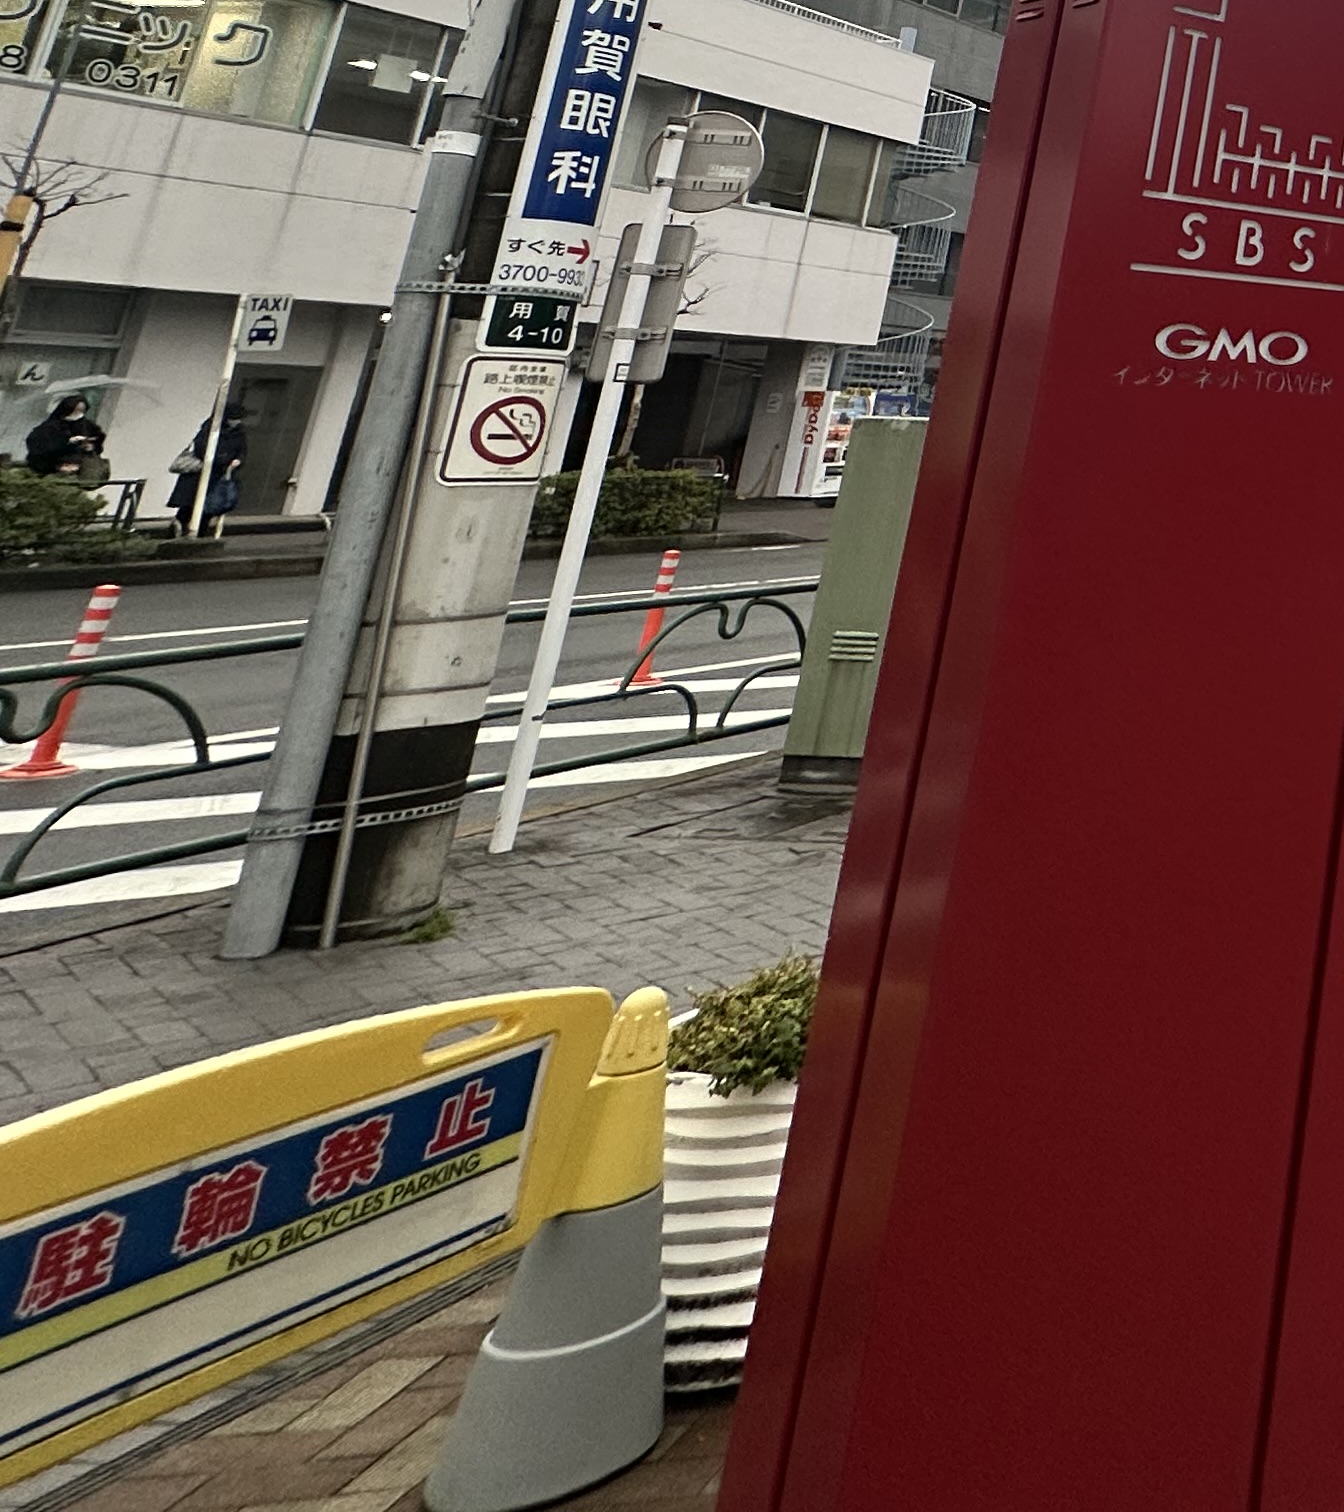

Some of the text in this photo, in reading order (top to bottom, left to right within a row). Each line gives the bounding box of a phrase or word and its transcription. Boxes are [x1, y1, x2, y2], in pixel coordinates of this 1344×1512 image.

[1, 44, 180, 98] 8 0311
[507, 238, 566, 257] すぐ先
[1177, 211, 1316, 273] SBS
[251, 297, 290, 312] TAXI
[508, 301, 572, 323] 用賀
[507, 325, 564, 345] 4-10
[1155, 323, 1309, 366] GMO
[13, 1076, 497, 1321] 駐輪禁止
[226, 1152, 482, 1272] NO BICYCLES PARKING
